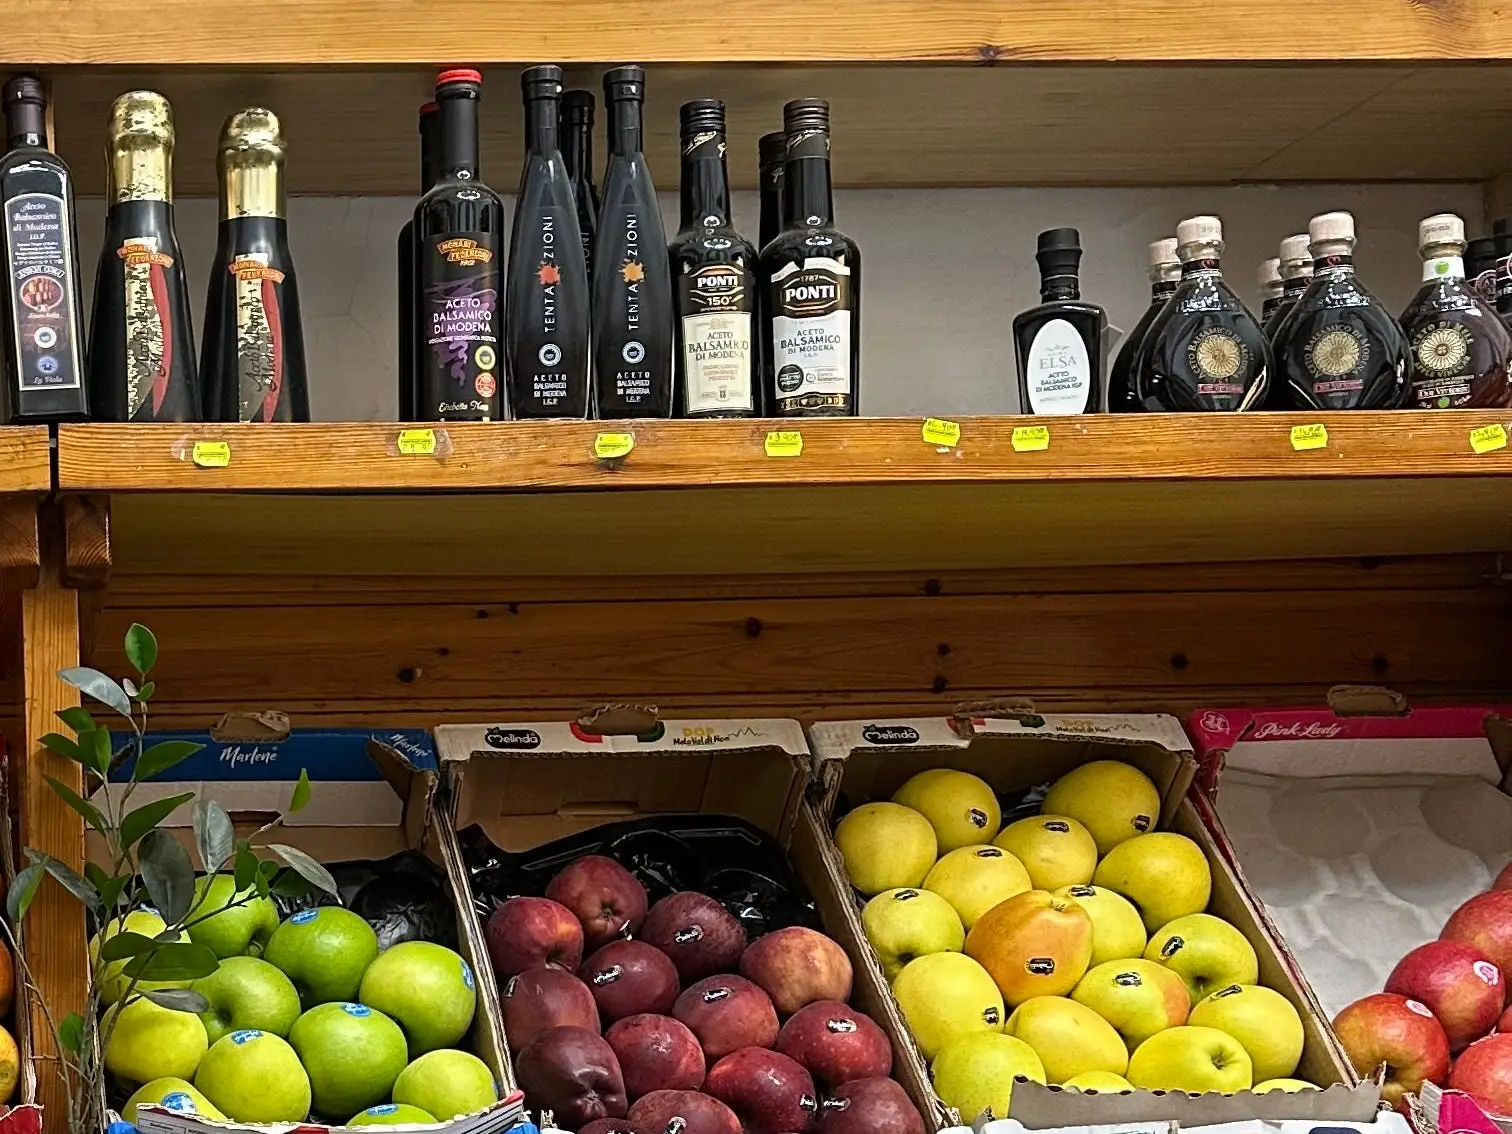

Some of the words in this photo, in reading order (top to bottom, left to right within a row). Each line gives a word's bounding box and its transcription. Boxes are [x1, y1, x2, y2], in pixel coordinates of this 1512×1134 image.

[697, 275, 738, 288] PONTI
[785, 285, 834, 302] PONTI
[445, 298, 481, 309] ACETO
[433, 310, 492, 323] BALSAMICO
[434, 324, 445, 335] DI
[447, 321, 492, 333] MODENA
[797, 328, 825, 337] ACETO
[707, 331, 734, 340] ACETO
[780, 335, 841, 349] BALSAMICO
[688, 340, 749, 354] BALSAMICO
[799, 344, 835, 353] MODENA
[708, 351, 744, 361] MODENA
[1040, 355, 1077, 369] ELSA
[534, 374, 567, 382] ACETO
[617, 372, 650, 380] ACETO
[865, 727, 918, 741] Melinda
[1254, 723, 1298, 739] Pink
[1298, 721, 1341, 738] Lady
[488, 733, 539, 745] Melinda
[219, 747, 278, 769] Marlene
